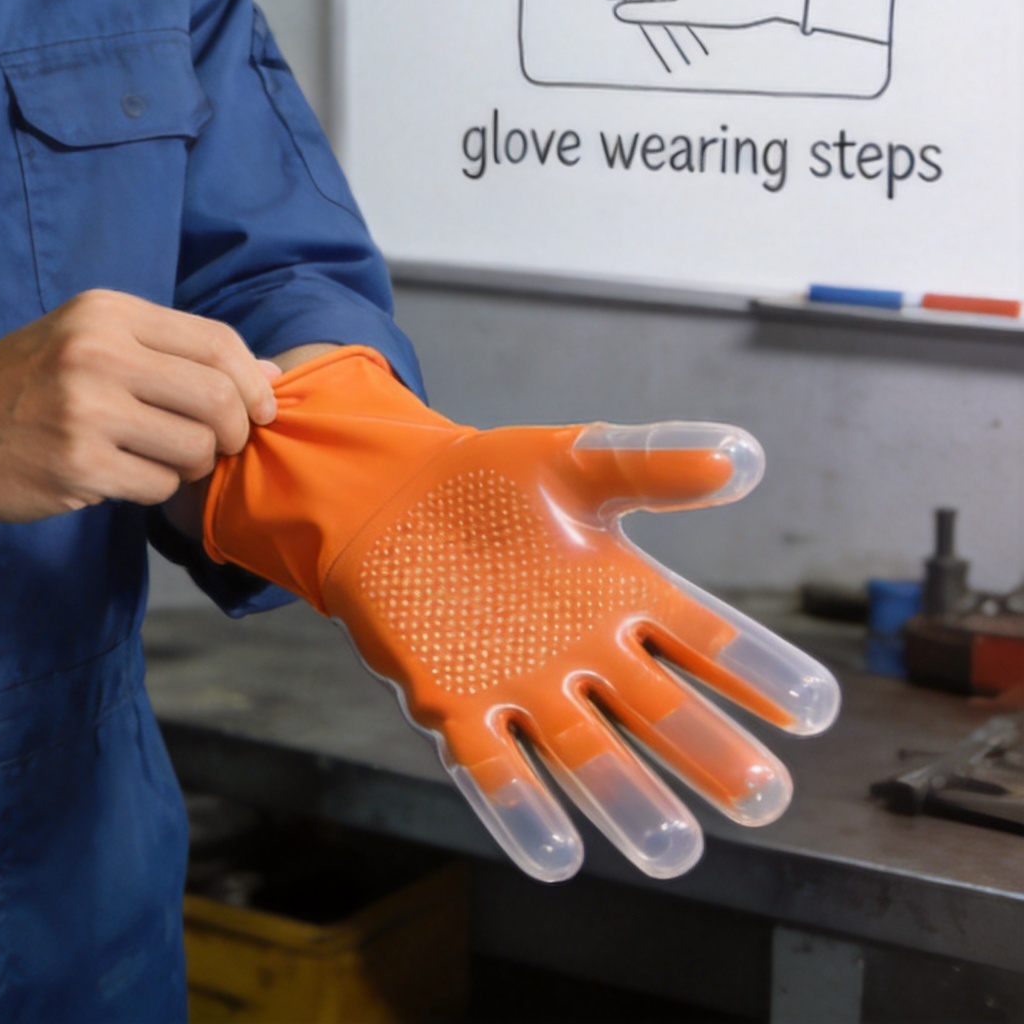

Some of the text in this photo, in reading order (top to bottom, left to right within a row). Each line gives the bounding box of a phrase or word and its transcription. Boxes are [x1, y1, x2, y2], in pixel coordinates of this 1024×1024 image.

[461, 107, 943, 201] glove wearing steps
